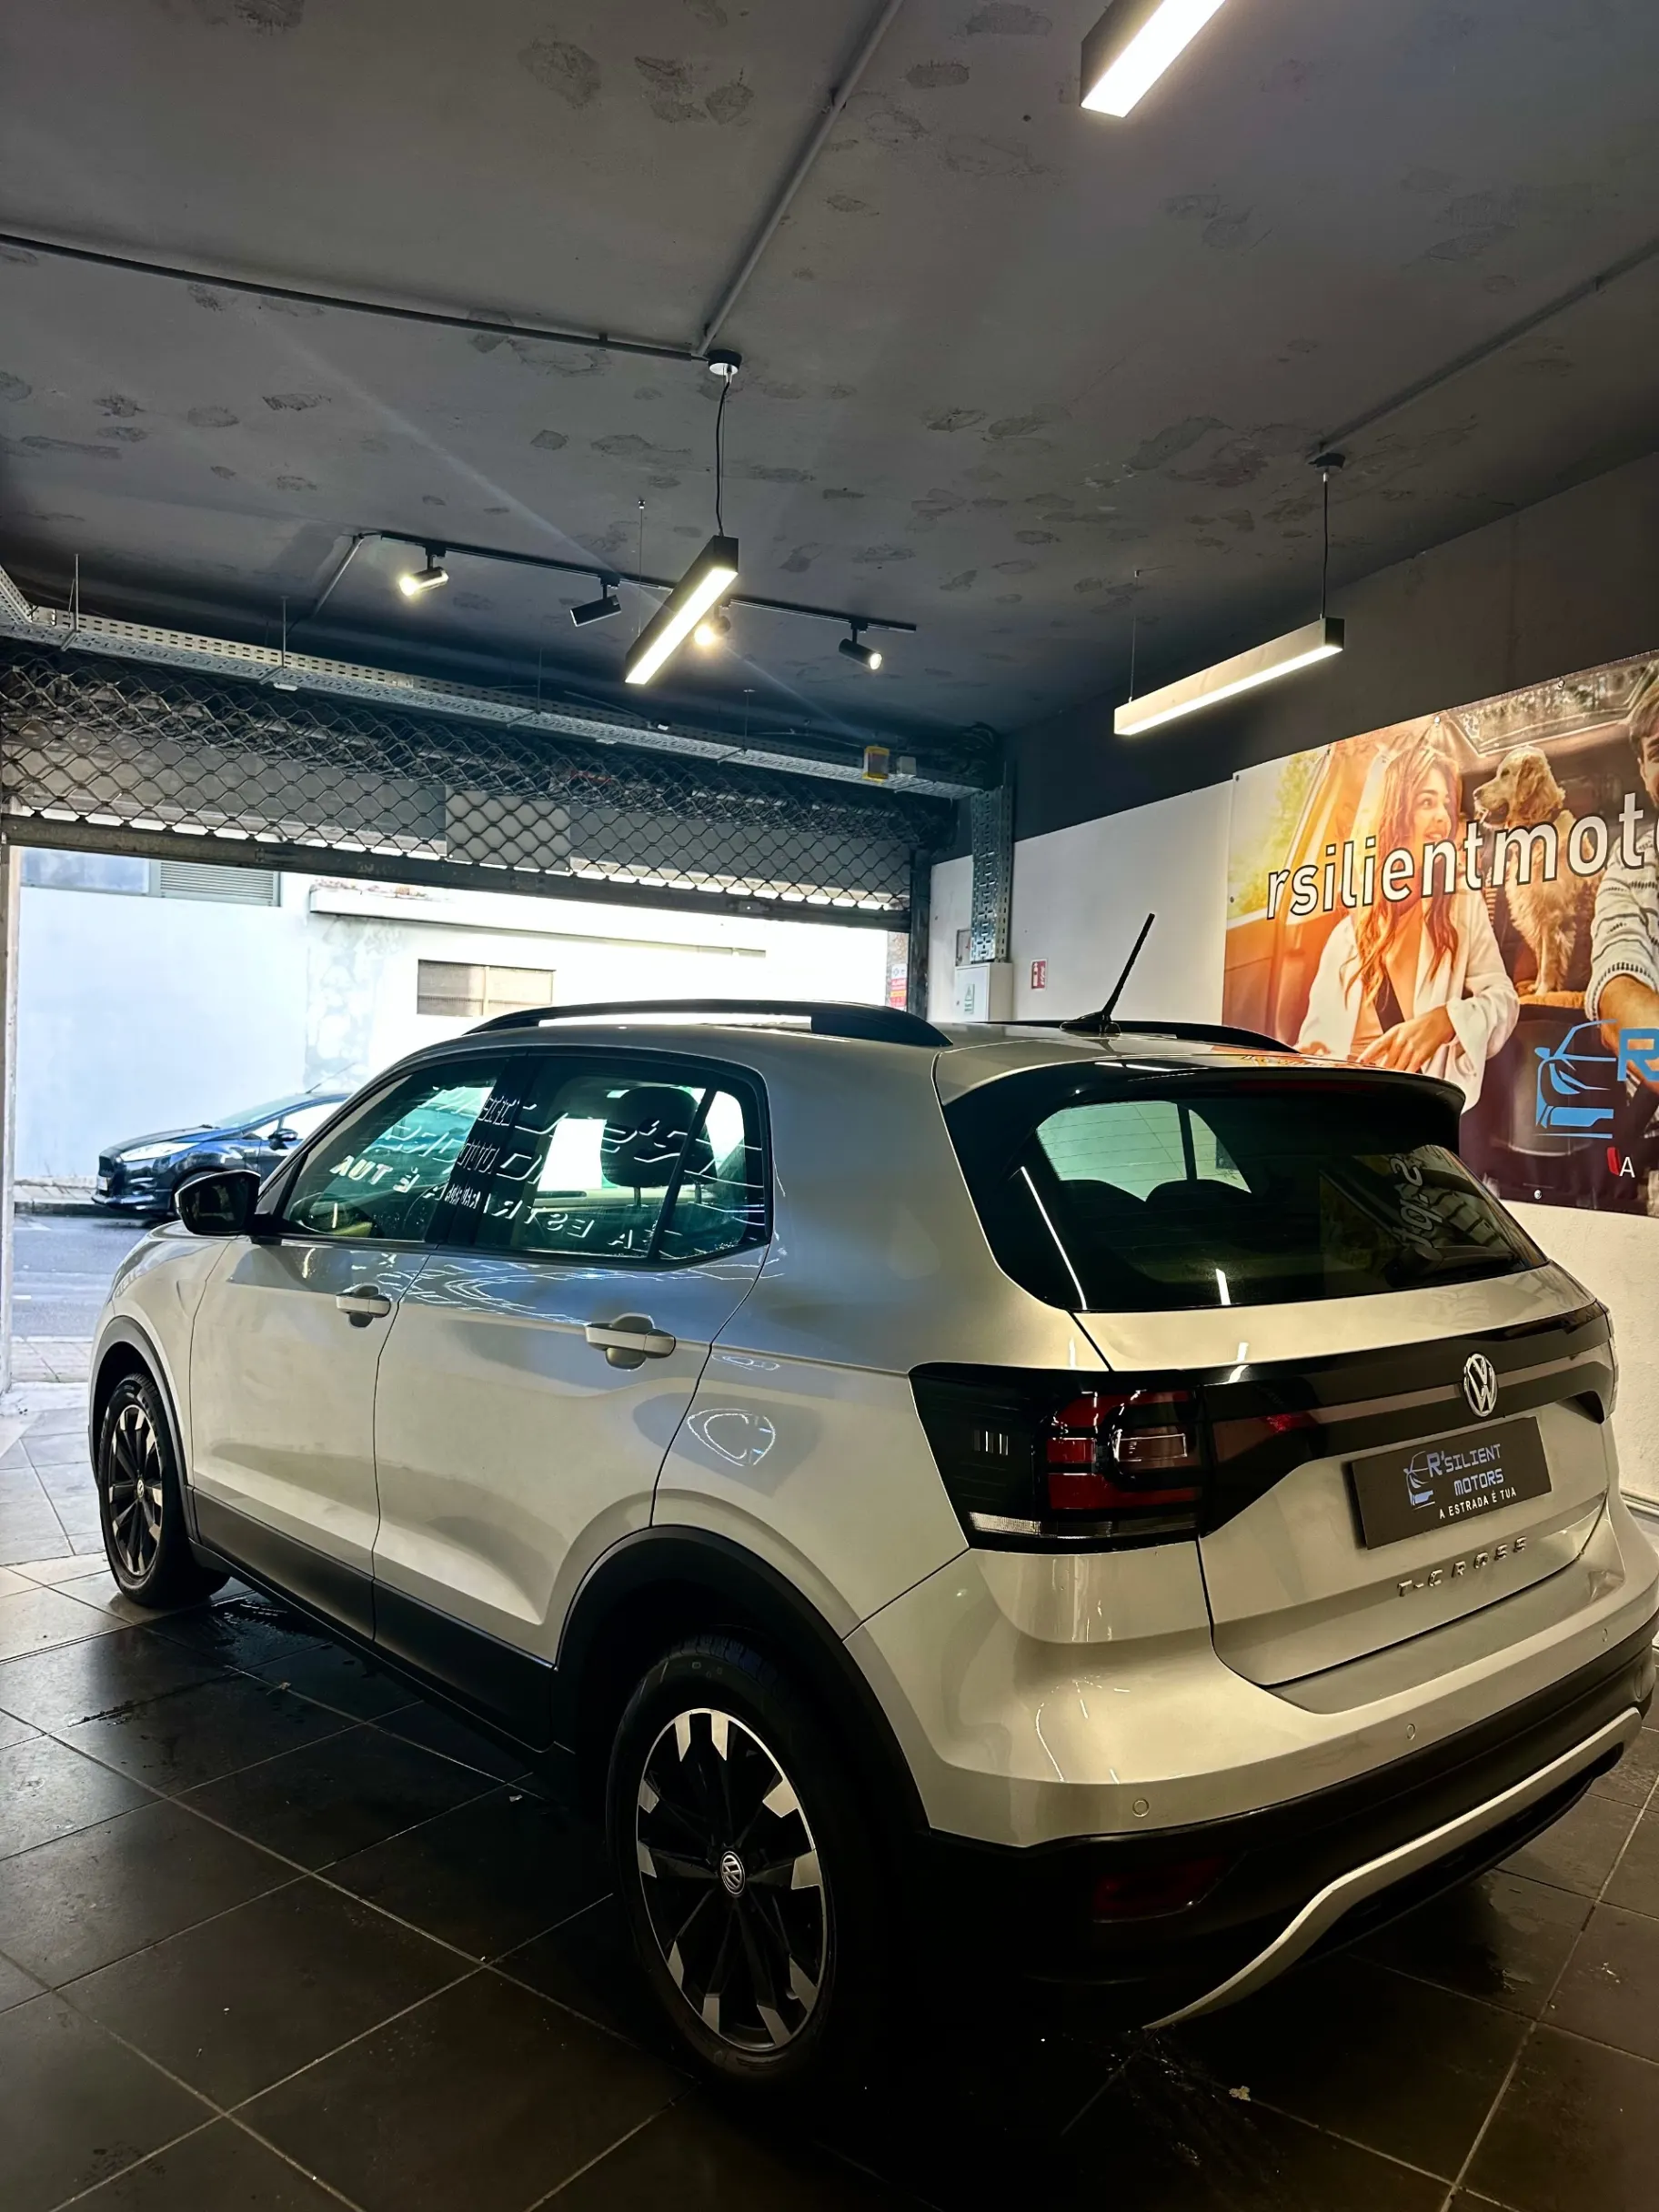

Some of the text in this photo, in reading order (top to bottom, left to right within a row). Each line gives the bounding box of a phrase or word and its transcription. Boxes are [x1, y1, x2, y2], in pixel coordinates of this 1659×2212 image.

[1266, 791, 1659, 920] rsilientmot
[1619, 1156, 1636, 1179] A
[1425, 1443, 1502, 1478] R'SILIENT
[1453, 1467, 1505, 1496] MOTORS
[1439, 1508, 1446, 1520] A
[1448, 1494, 1490, 1517] ESTRADA
[1500, 1486, 1518, 1501] TUA
[1397, 1535, 1528, 1598] T-CROSS
